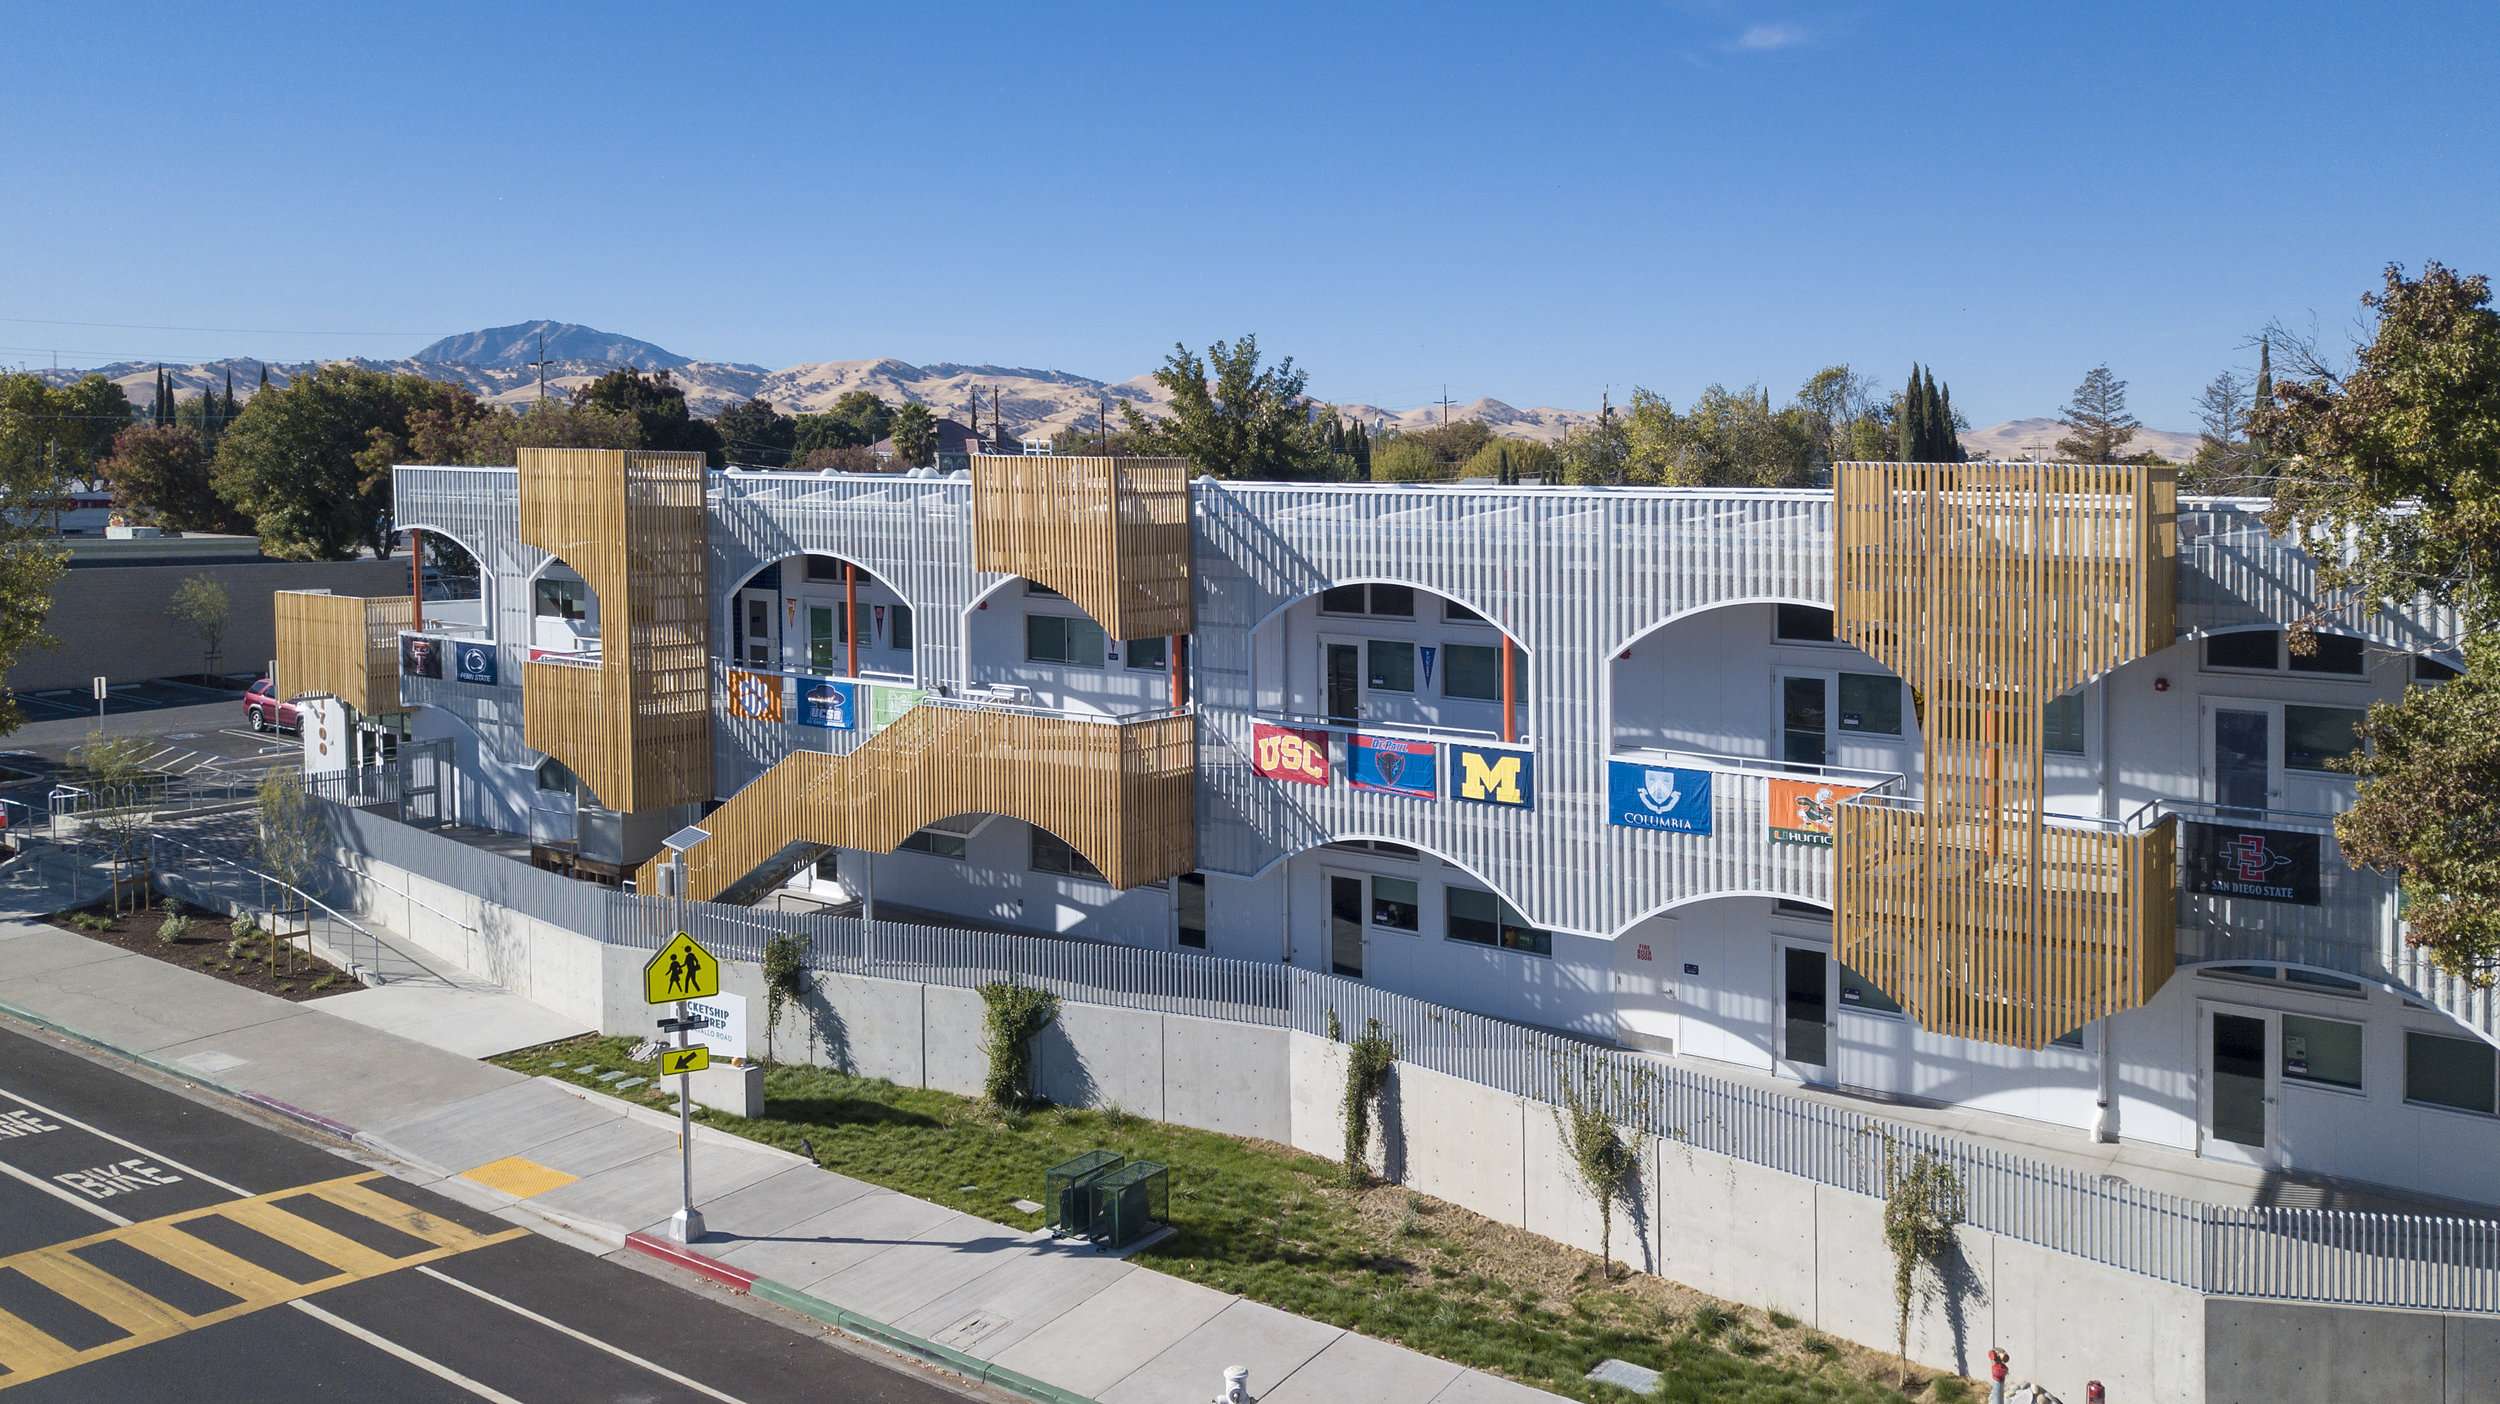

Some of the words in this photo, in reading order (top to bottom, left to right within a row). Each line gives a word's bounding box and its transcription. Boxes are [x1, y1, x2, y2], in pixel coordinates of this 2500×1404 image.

[474, 674, 491, 683] STATE
[1258, 735, 1323, 779] USC
[1462, 752, 1521, 804] M
[1624, 812, 1692, 830] COLUMBIA
[1788, 832, 1833, 844] HURRIC
[2211, 880, 2230, 891] SAN
[2232, 882, 2262, 895] DIEGO
[2263, 886, 2294, 898] STATE
[687, 1001, 730, 1020] CKETSHIP
[53, 1159, 184, 1199] BIKE
